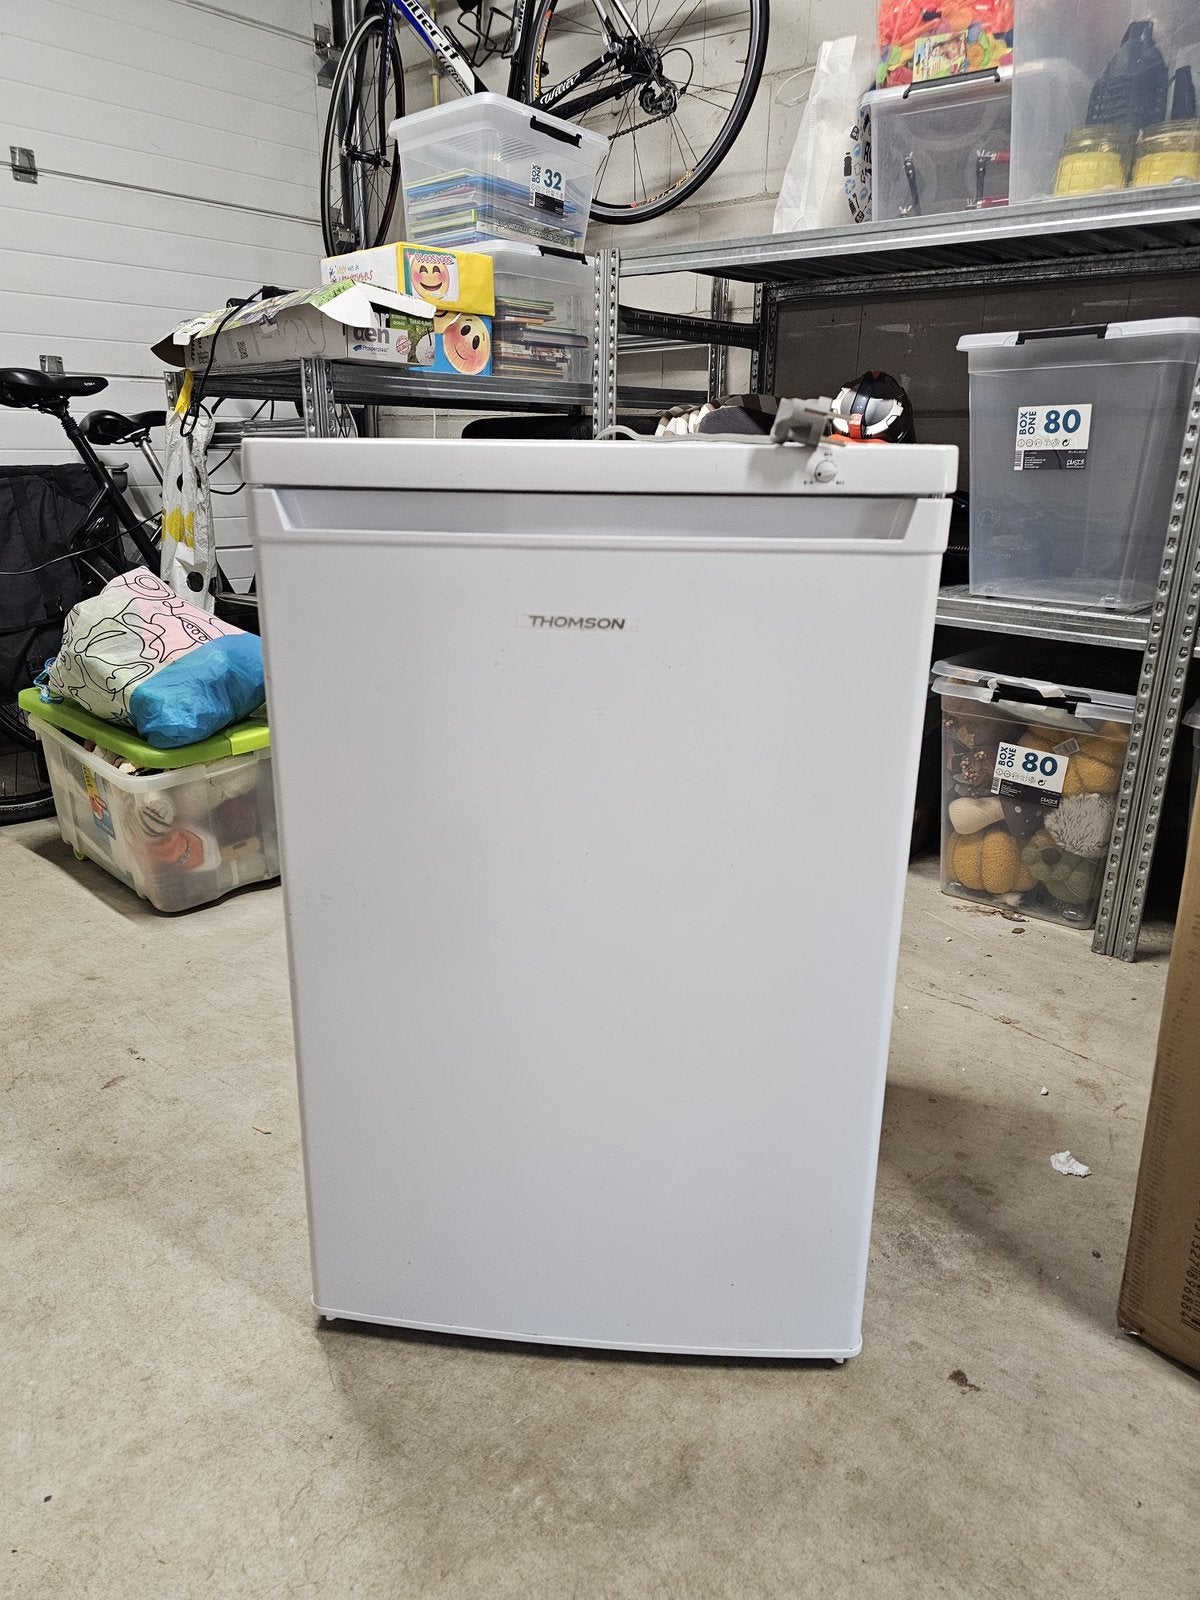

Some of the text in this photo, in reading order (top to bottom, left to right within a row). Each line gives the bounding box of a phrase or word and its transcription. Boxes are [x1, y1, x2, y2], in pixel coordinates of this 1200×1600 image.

[402, 0, 459, 59] ilier.it
[544, 169, 562, 190] 32
[1019, 411, 1028, 435] BOX
[1027, 411, 1037, 435] ONE
[1043, 409, 1081, 434] 80
[528, 615, 626, 630] THOMSON
[998, 746, 1009, 766] BOX
[1006, 747, 1017, 768] ONE
[1022, 752, 1058, 777] 80
